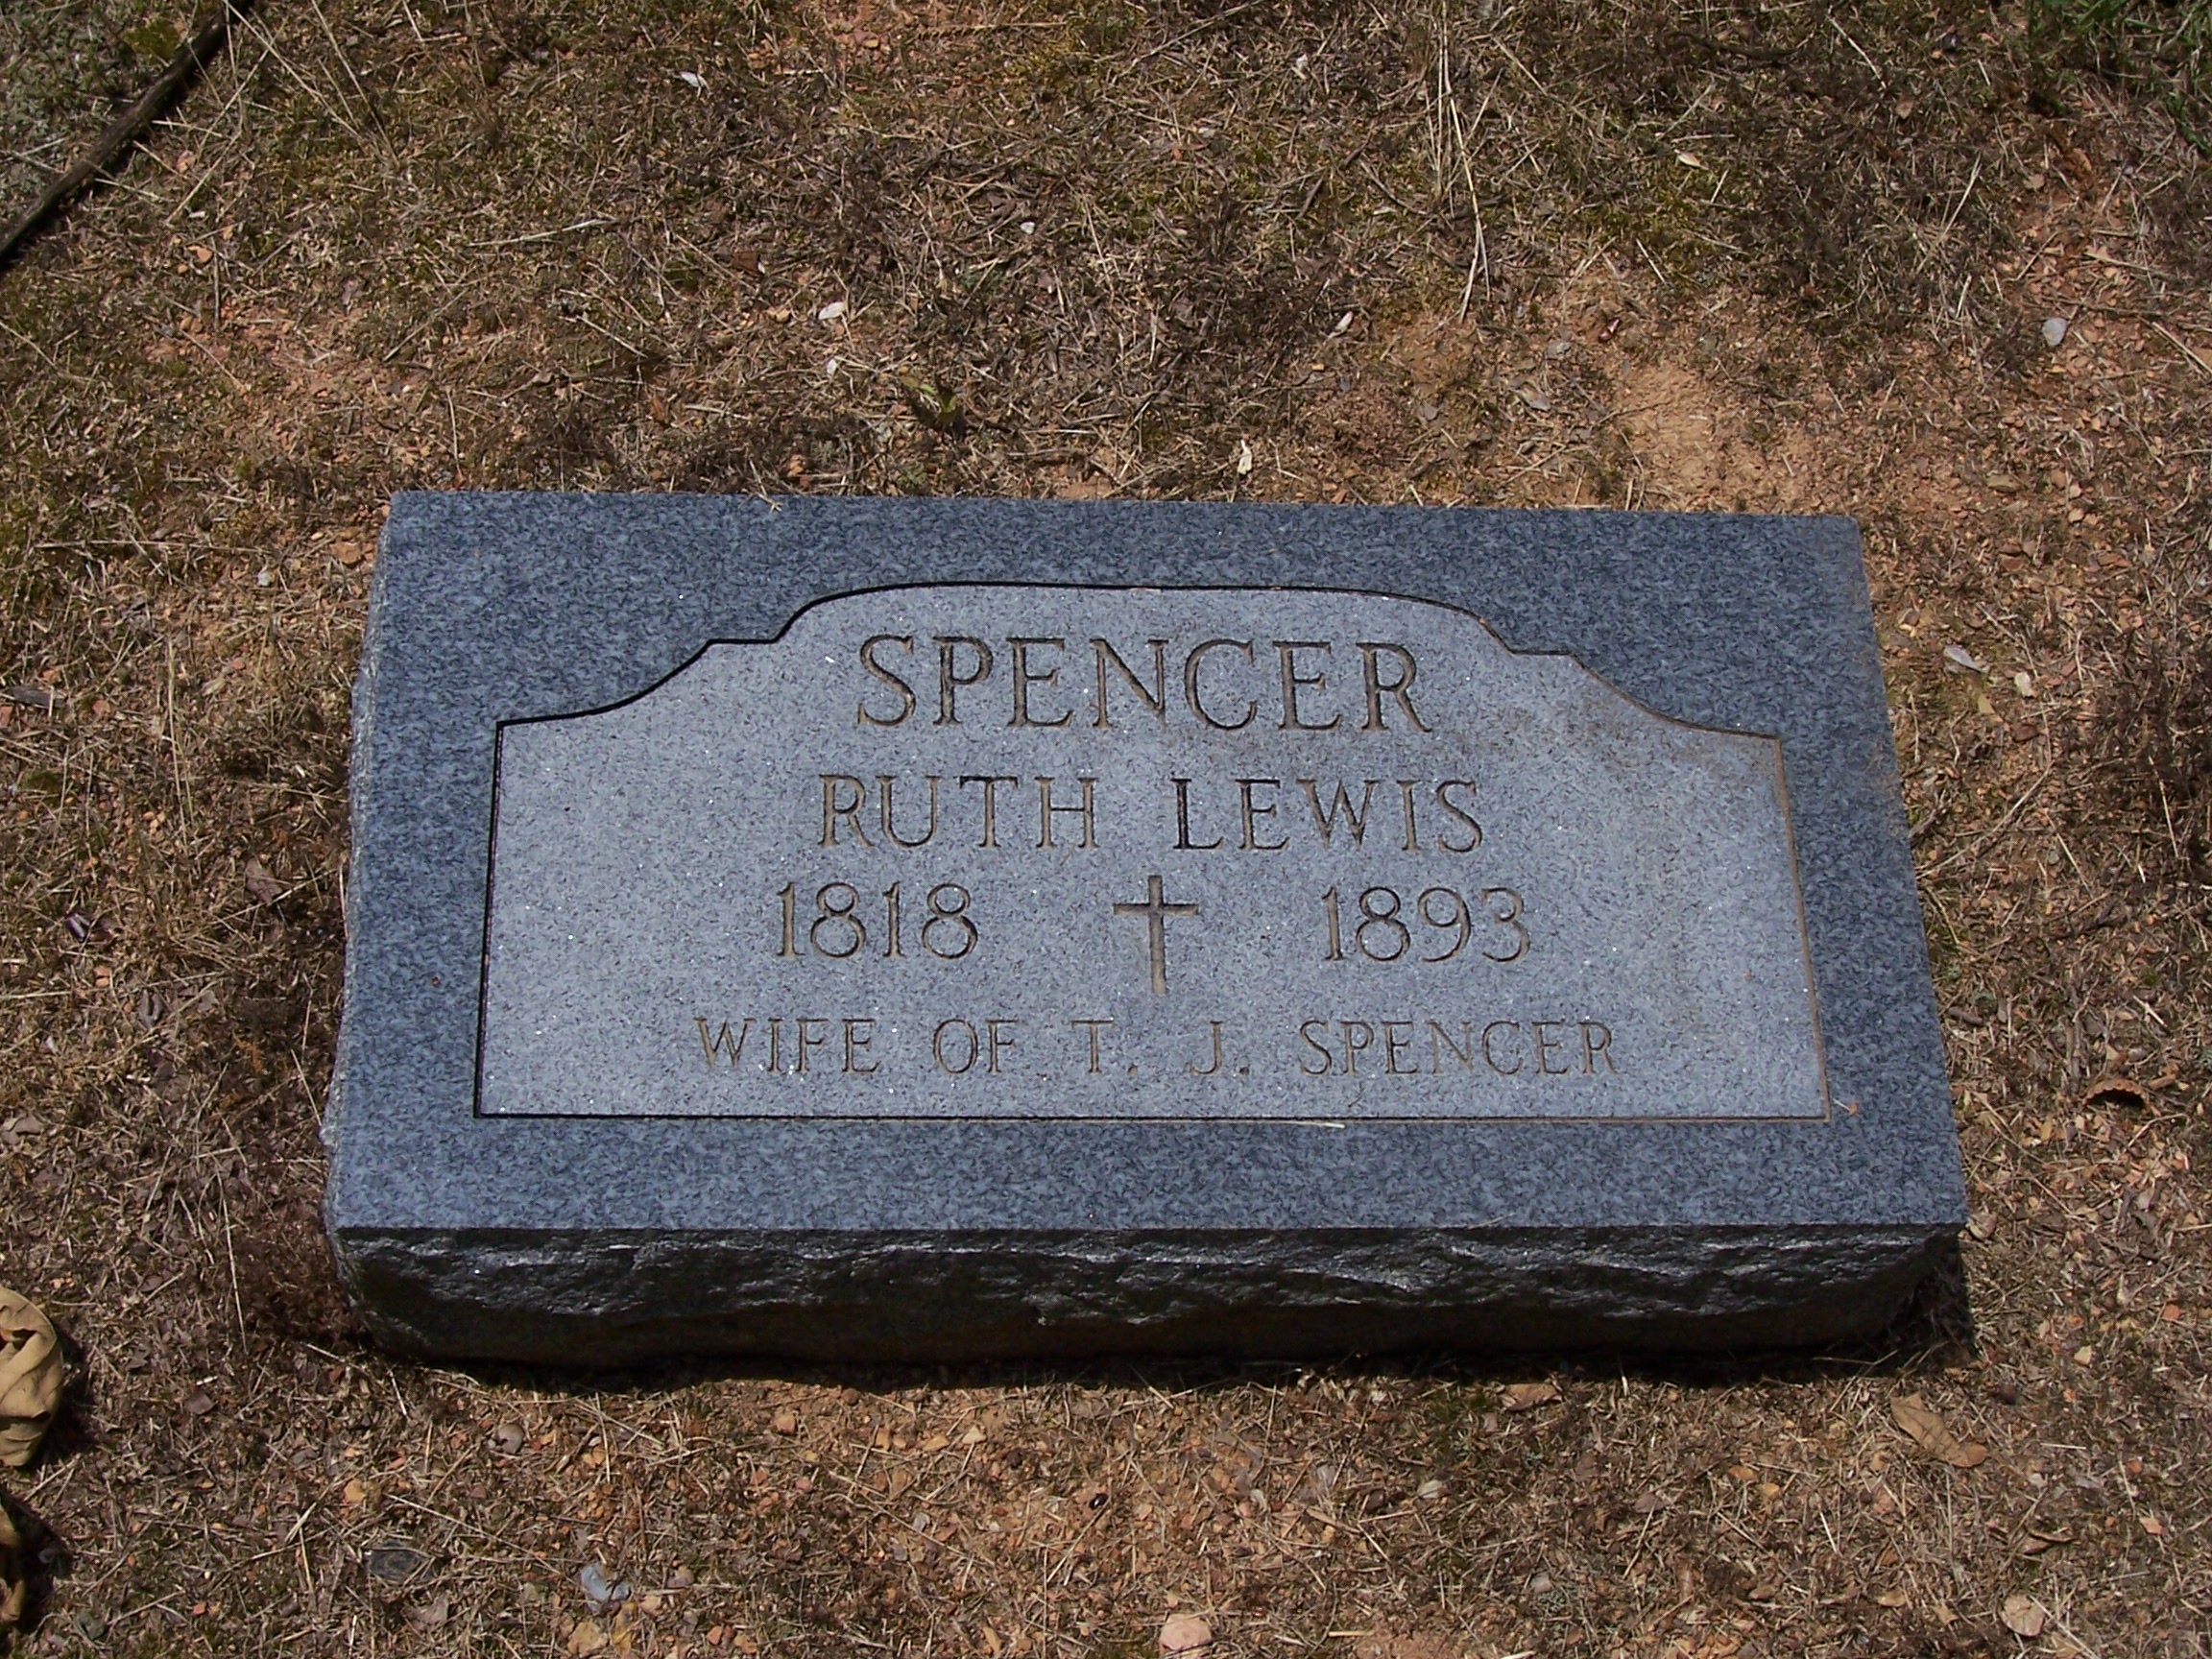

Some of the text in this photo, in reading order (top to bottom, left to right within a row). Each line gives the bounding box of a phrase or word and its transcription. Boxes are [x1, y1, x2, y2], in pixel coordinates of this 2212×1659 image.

[856, 634, 1434, 733] SPENCER
[816, 773, 1485, 854] RUTH LEWIS
[775, 879, 1531, 964] 1818 1893
[692, 1016, 1623, 1077] WIFE OF T. J. SPENCER
